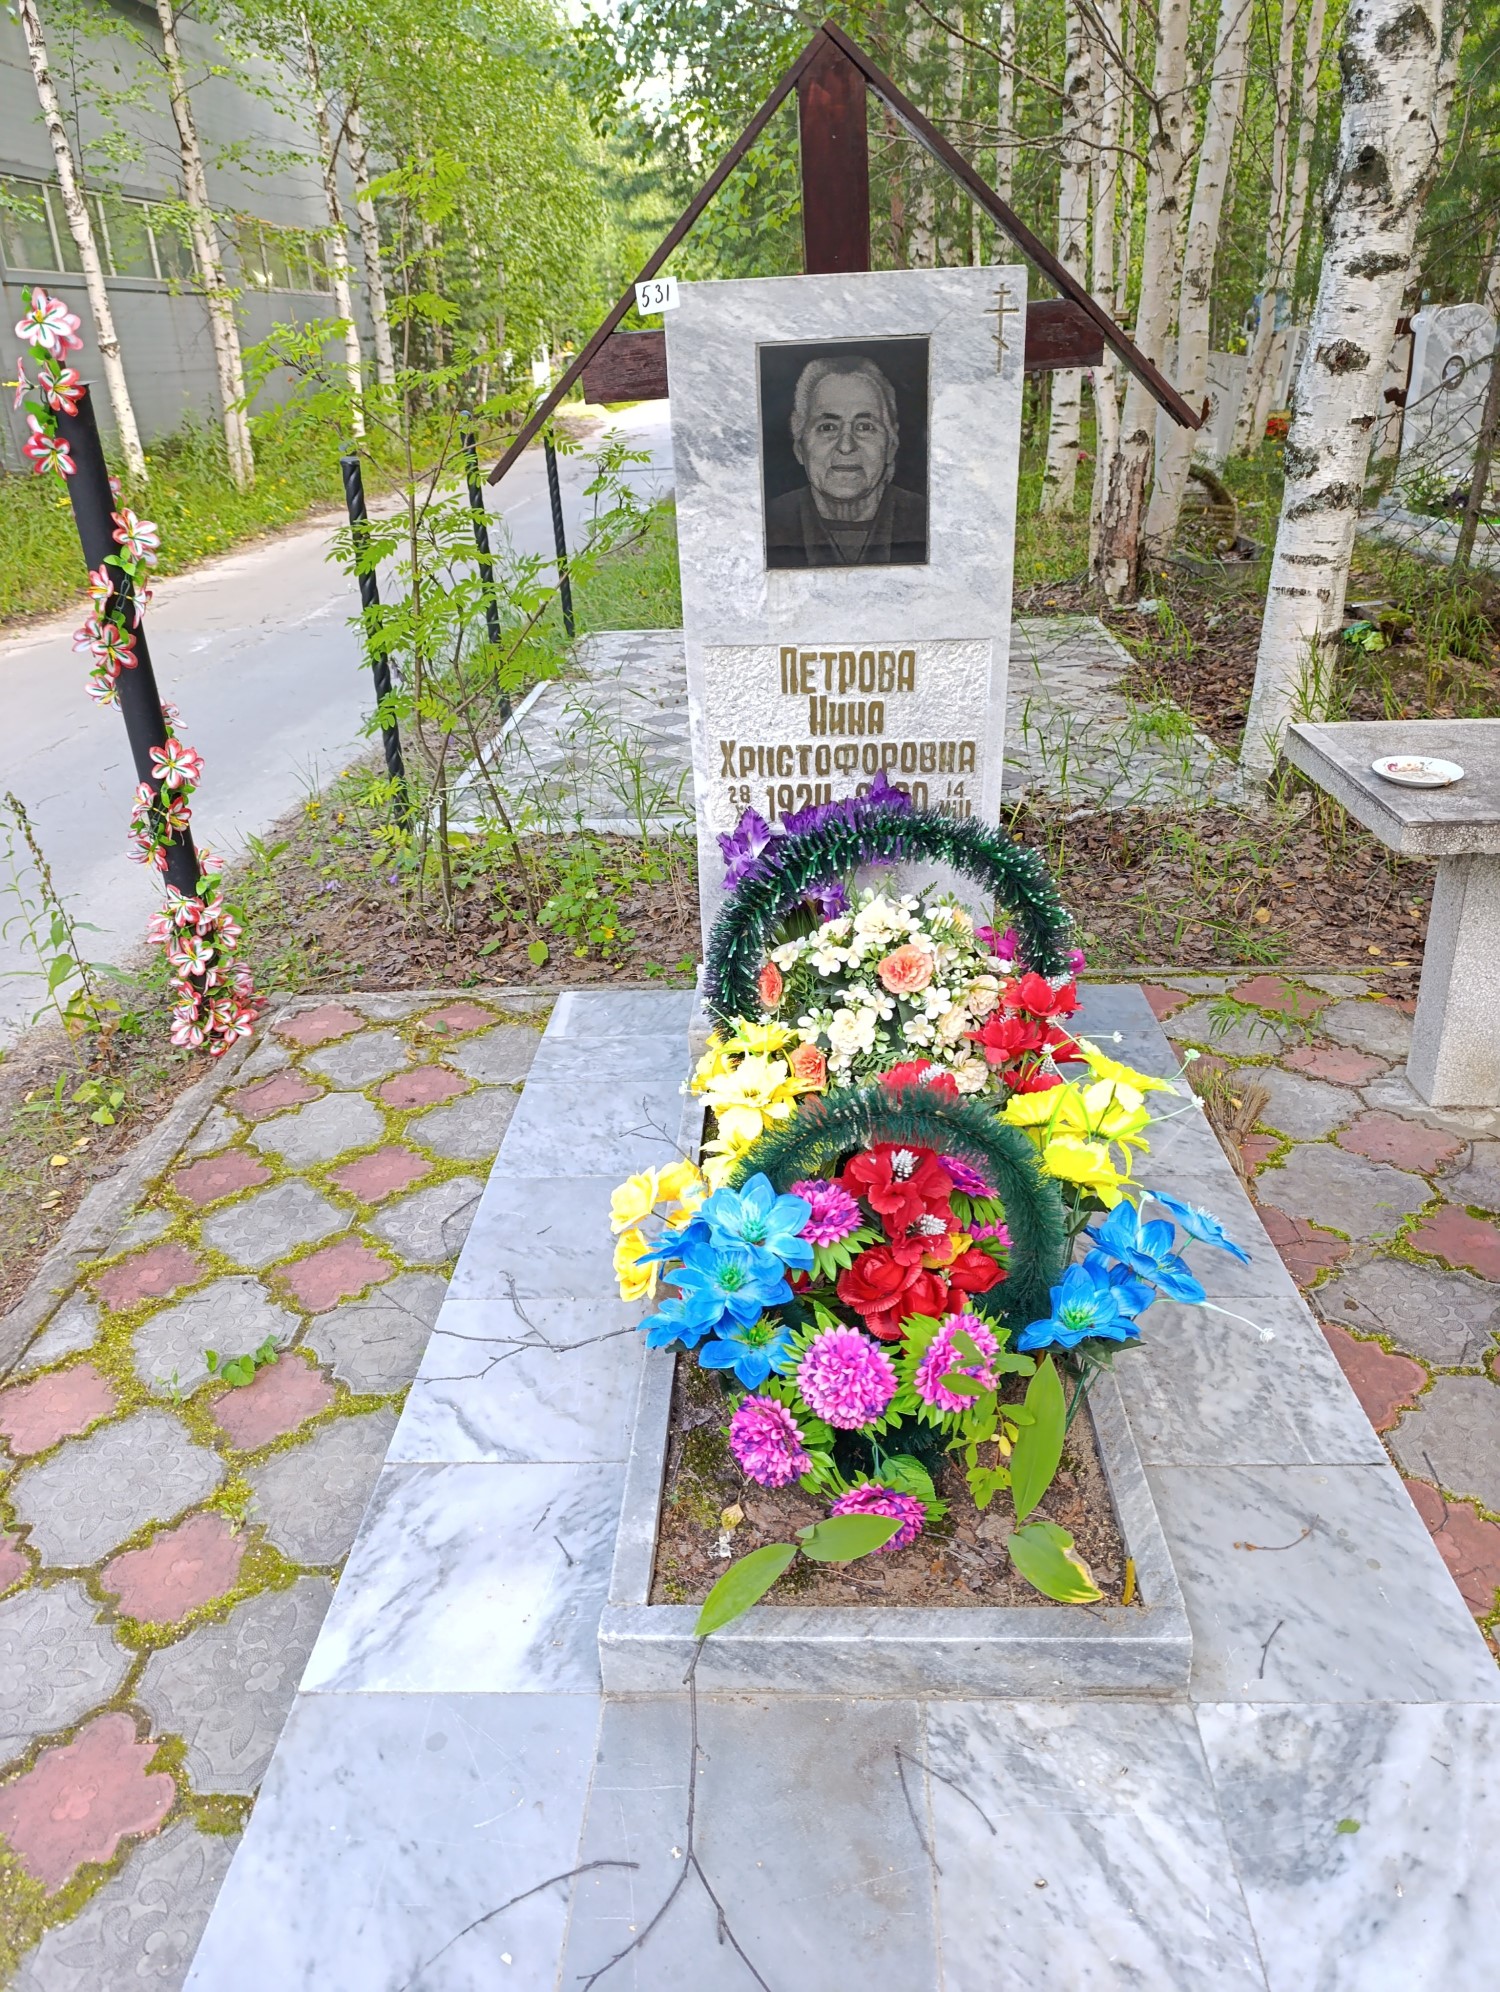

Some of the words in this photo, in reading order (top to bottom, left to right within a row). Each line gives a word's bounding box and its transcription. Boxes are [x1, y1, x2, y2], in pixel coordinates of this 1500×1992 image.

[642, 284, 670, 308] 531
[780, 647, 916, 694] ПЕТРОВА
[728, 784, 751, 804] 28
[946, 780, 965, 798] 14
